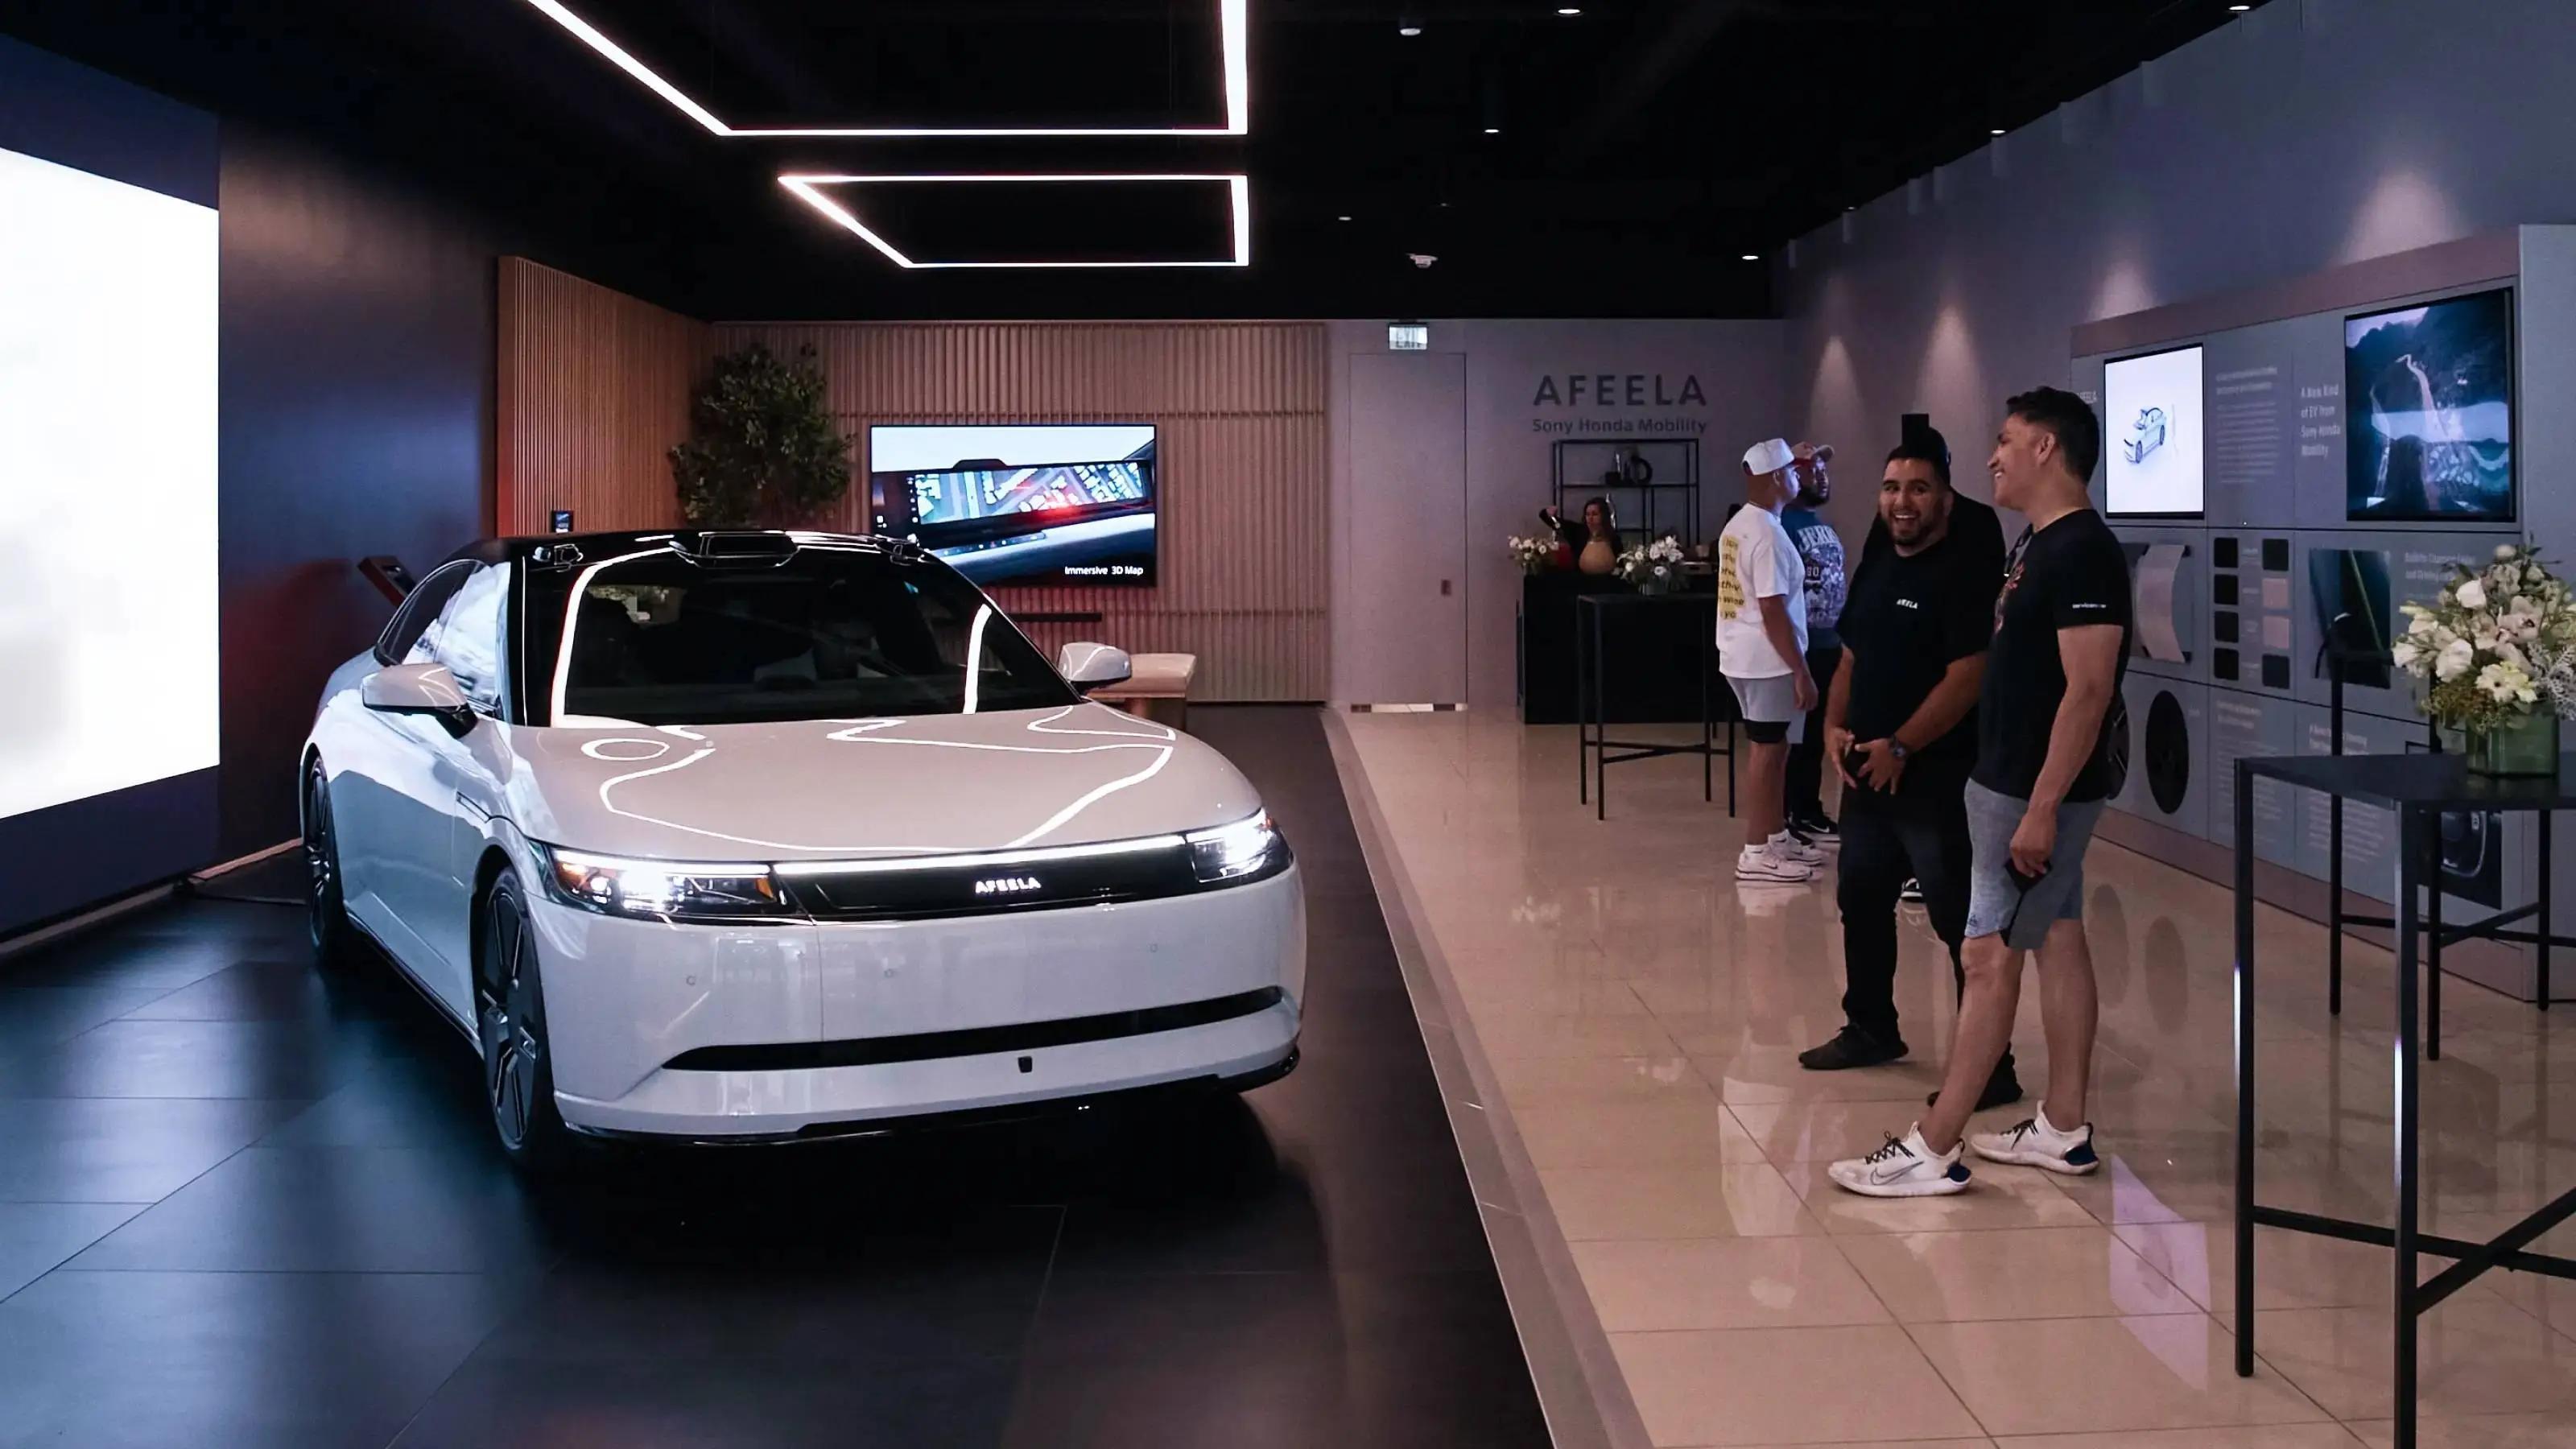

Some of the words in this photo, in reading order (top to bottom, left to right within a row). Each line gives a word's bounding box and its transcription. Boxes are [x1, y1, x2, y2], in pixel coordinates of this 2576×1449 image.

[1533, 374, 1707, 406] AFEELA
[1533, 418, 1572, 434] Sony
[1579, 419, 1633, 432] Honda
[1638, 417, 1707, 434] Mobility
[1064, 566, 1108, 575] Immersive
[1111, 565, 1124, 575] 3D
[1125, 565, 1144, 576] Map
[975, 876, 1042, 894] AFEELA
